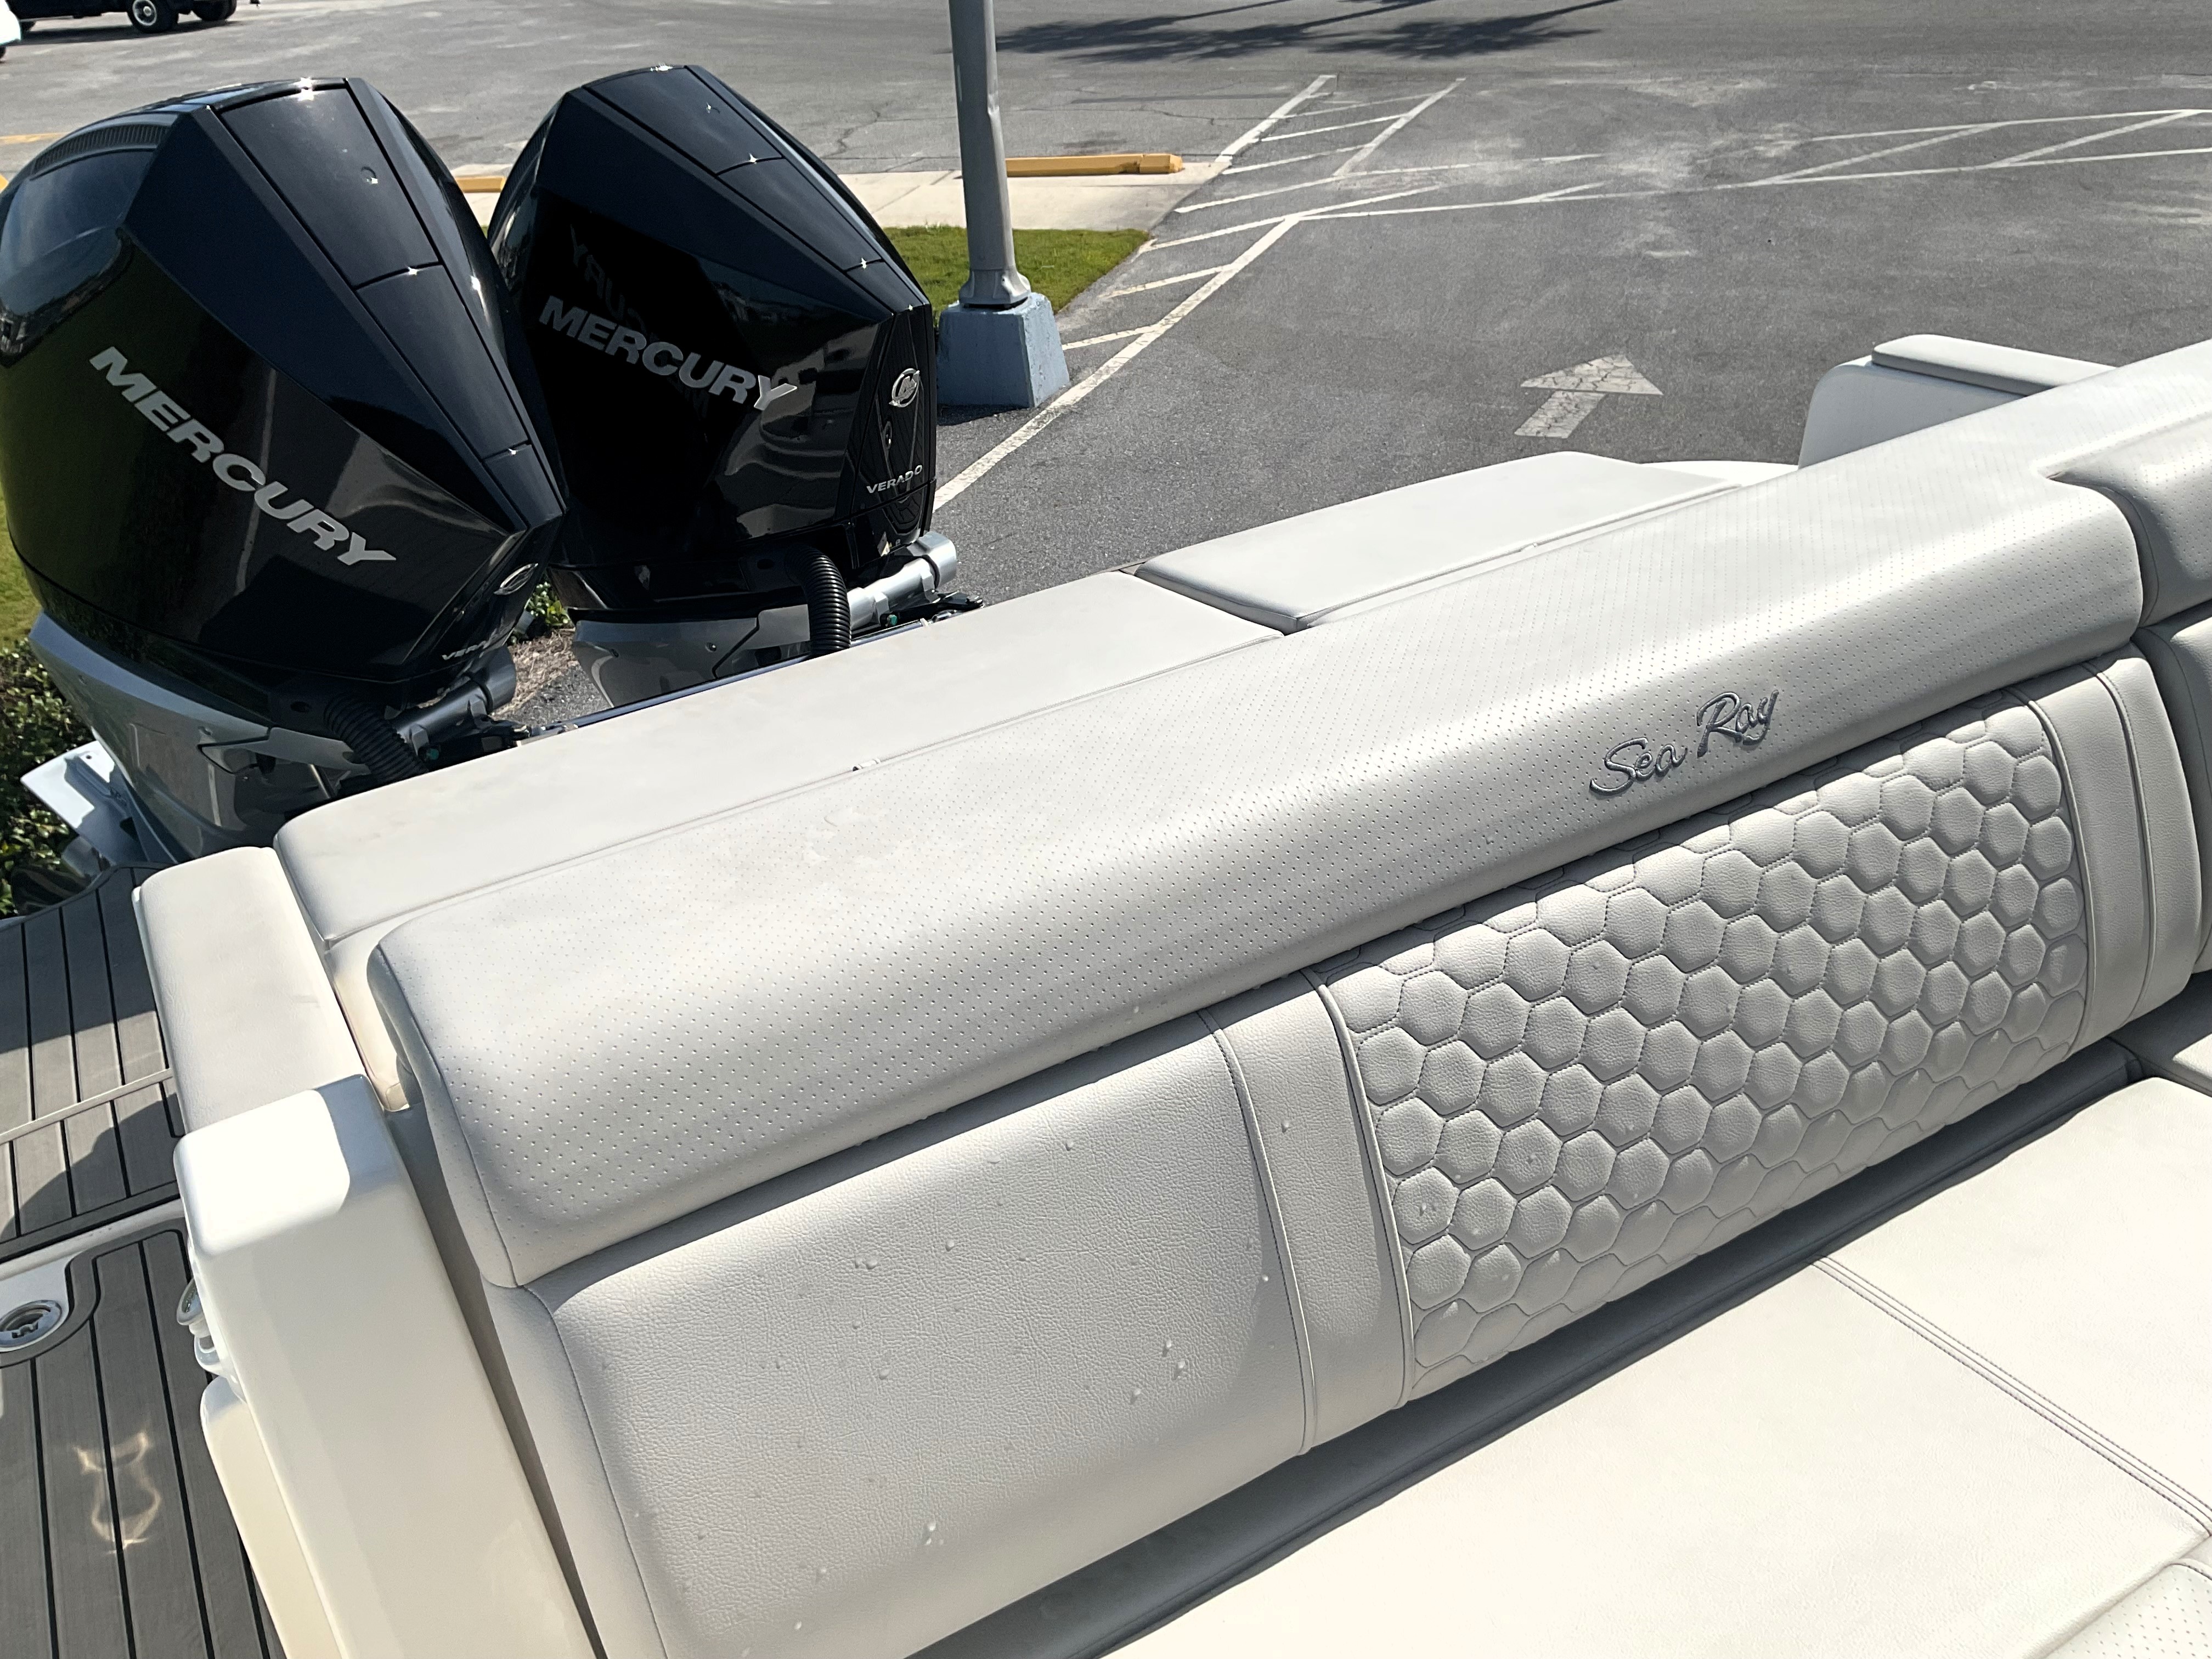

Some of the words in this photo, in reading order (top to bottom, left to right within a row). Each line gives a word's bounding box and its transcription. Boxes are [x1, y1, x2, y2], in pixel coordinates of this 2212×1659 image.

[538, 297, 798, 411] MERCURY
[89, 346, 397, 565] MERCURY
[866, 465, 923, 494] VERADO
[1589, 737, 1689, 797] Sea
[1696, 689, 1779, 758] Ray
